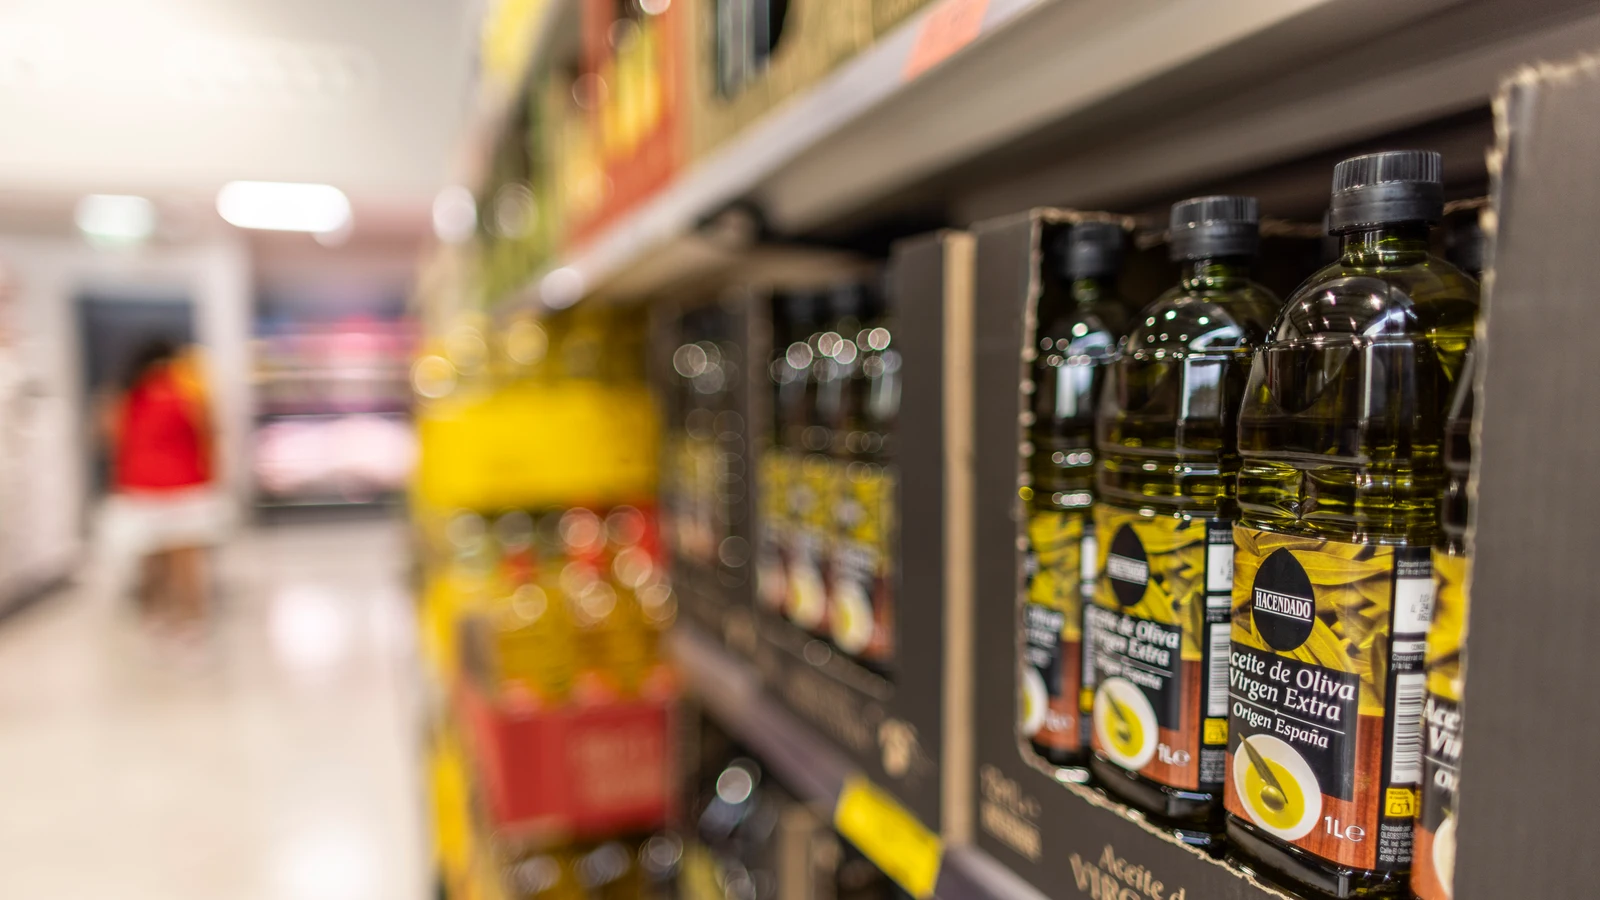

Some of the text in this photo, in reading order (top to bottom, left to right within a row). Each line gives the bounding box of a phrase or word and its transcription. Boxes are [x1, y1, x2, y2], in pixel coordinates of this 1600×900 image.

[1255, 590, 1312, 619] HACENDADO
[1136, 620, 1180, 649] Oliva
[1229, 667, 1342, 721] Virgen Extra
[1269, 661, 1291, 683] de
[1296, 669, 1356, 701] Oliva
[1232, 701, 1329, 748] Origen España
